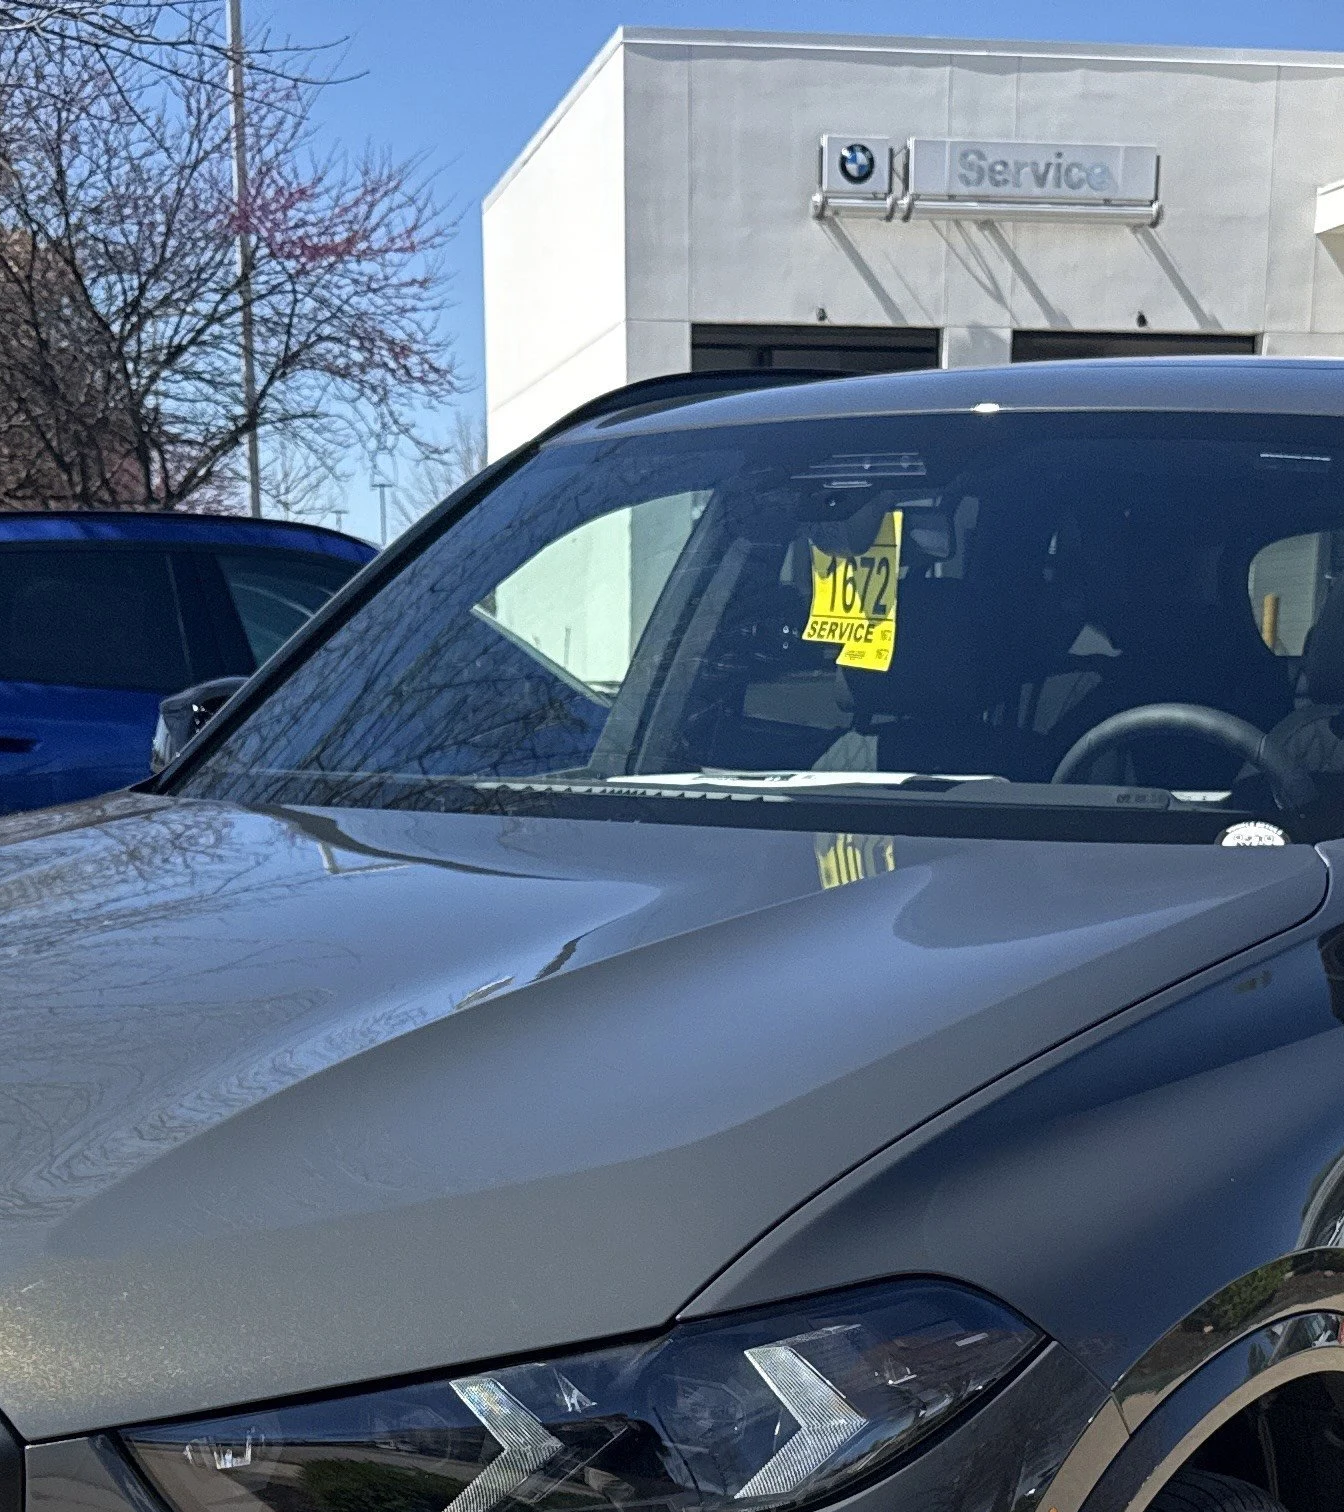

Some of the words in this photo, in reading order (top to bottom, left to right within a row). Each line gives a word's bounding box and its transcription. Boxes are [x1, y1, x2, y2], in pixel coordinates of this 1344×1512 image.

[957, 149, 1110, 191] Service
[827, 557, 889, 614] 1672
[808, 621, 875, 643] SERVICE
